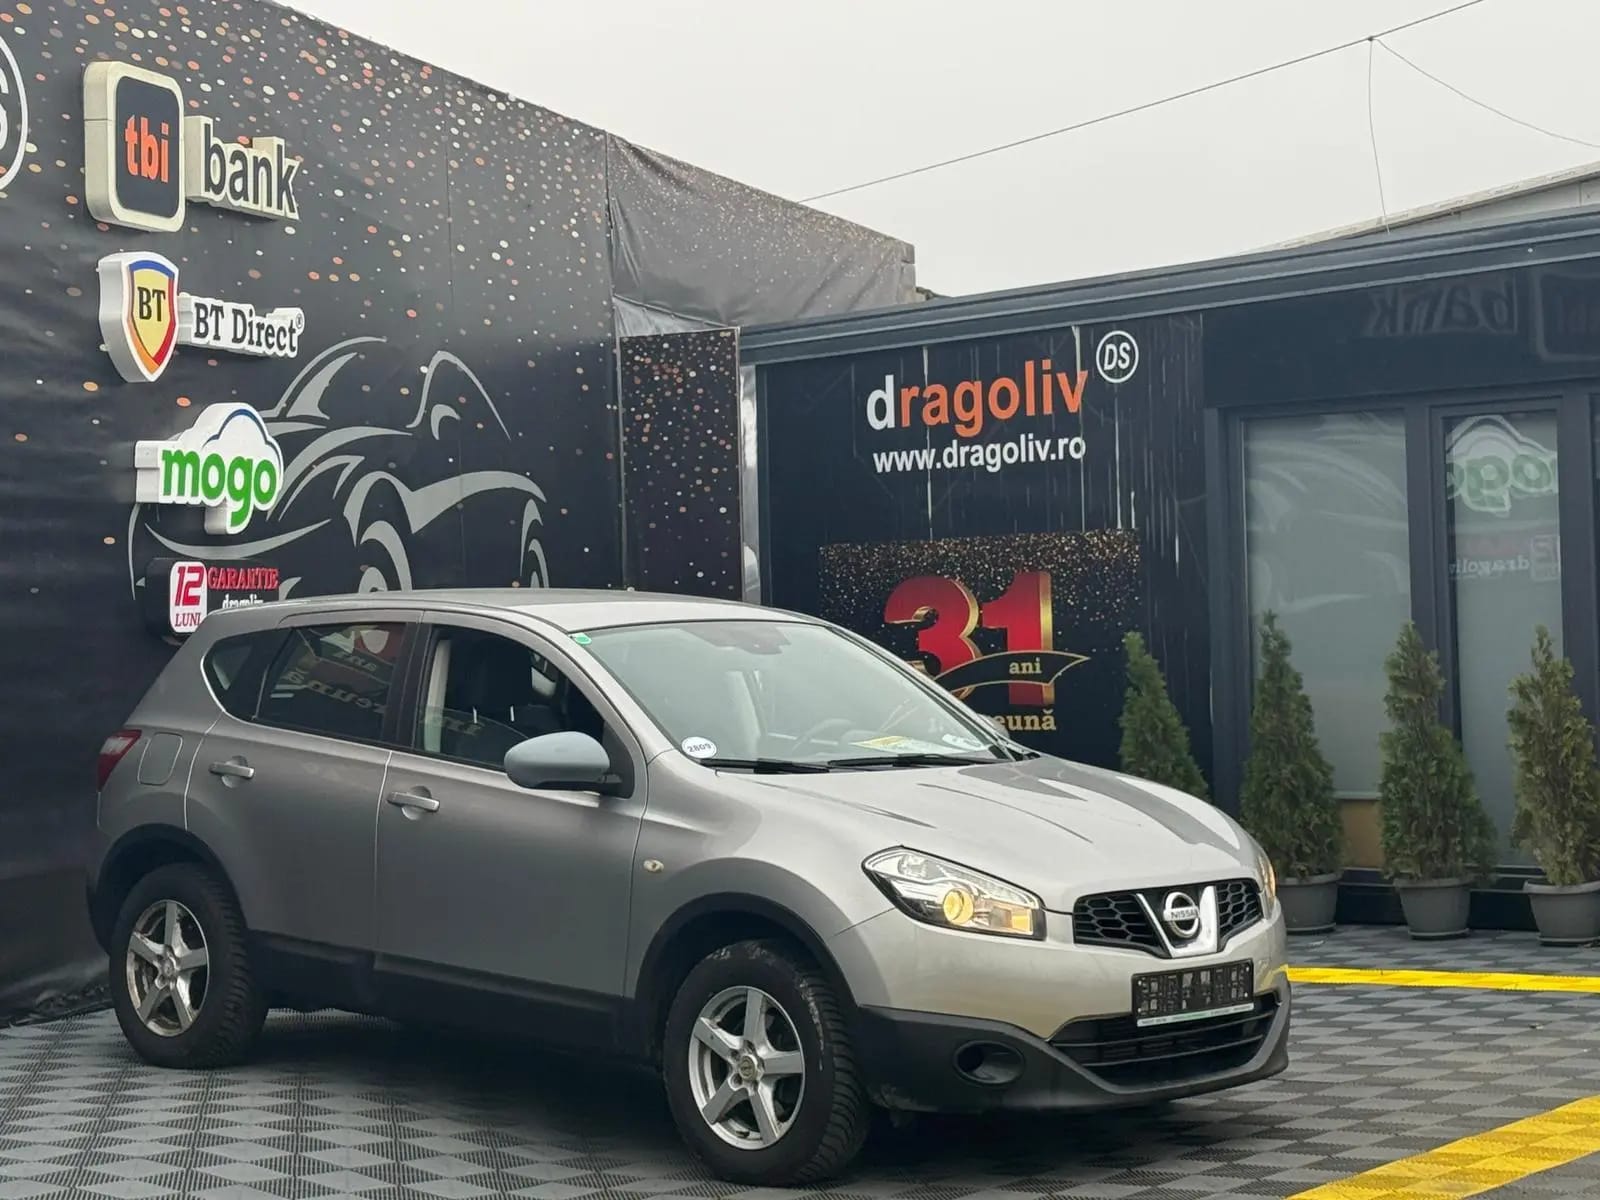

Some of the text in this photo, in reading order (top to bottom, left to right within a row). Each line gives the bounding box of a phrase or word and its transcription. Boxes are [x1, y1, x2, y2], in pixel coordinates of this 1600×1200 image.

[124, 115, 296, 213] tbi bank
[137, 287, 166, 323] BT
[194, 302, 224, 341] BT
[1103, 342, 1131, 371] DS
[866, 359, 1088, 437] dragoliv
[873, 433, 1087, 473] www.dragoliv.ro
[161, 449, 277, 527] mogo
[175, 566, 204, 606] 12
[884, 571, 1055, 706] 31
[1009, 657, 1042, 675] ani
